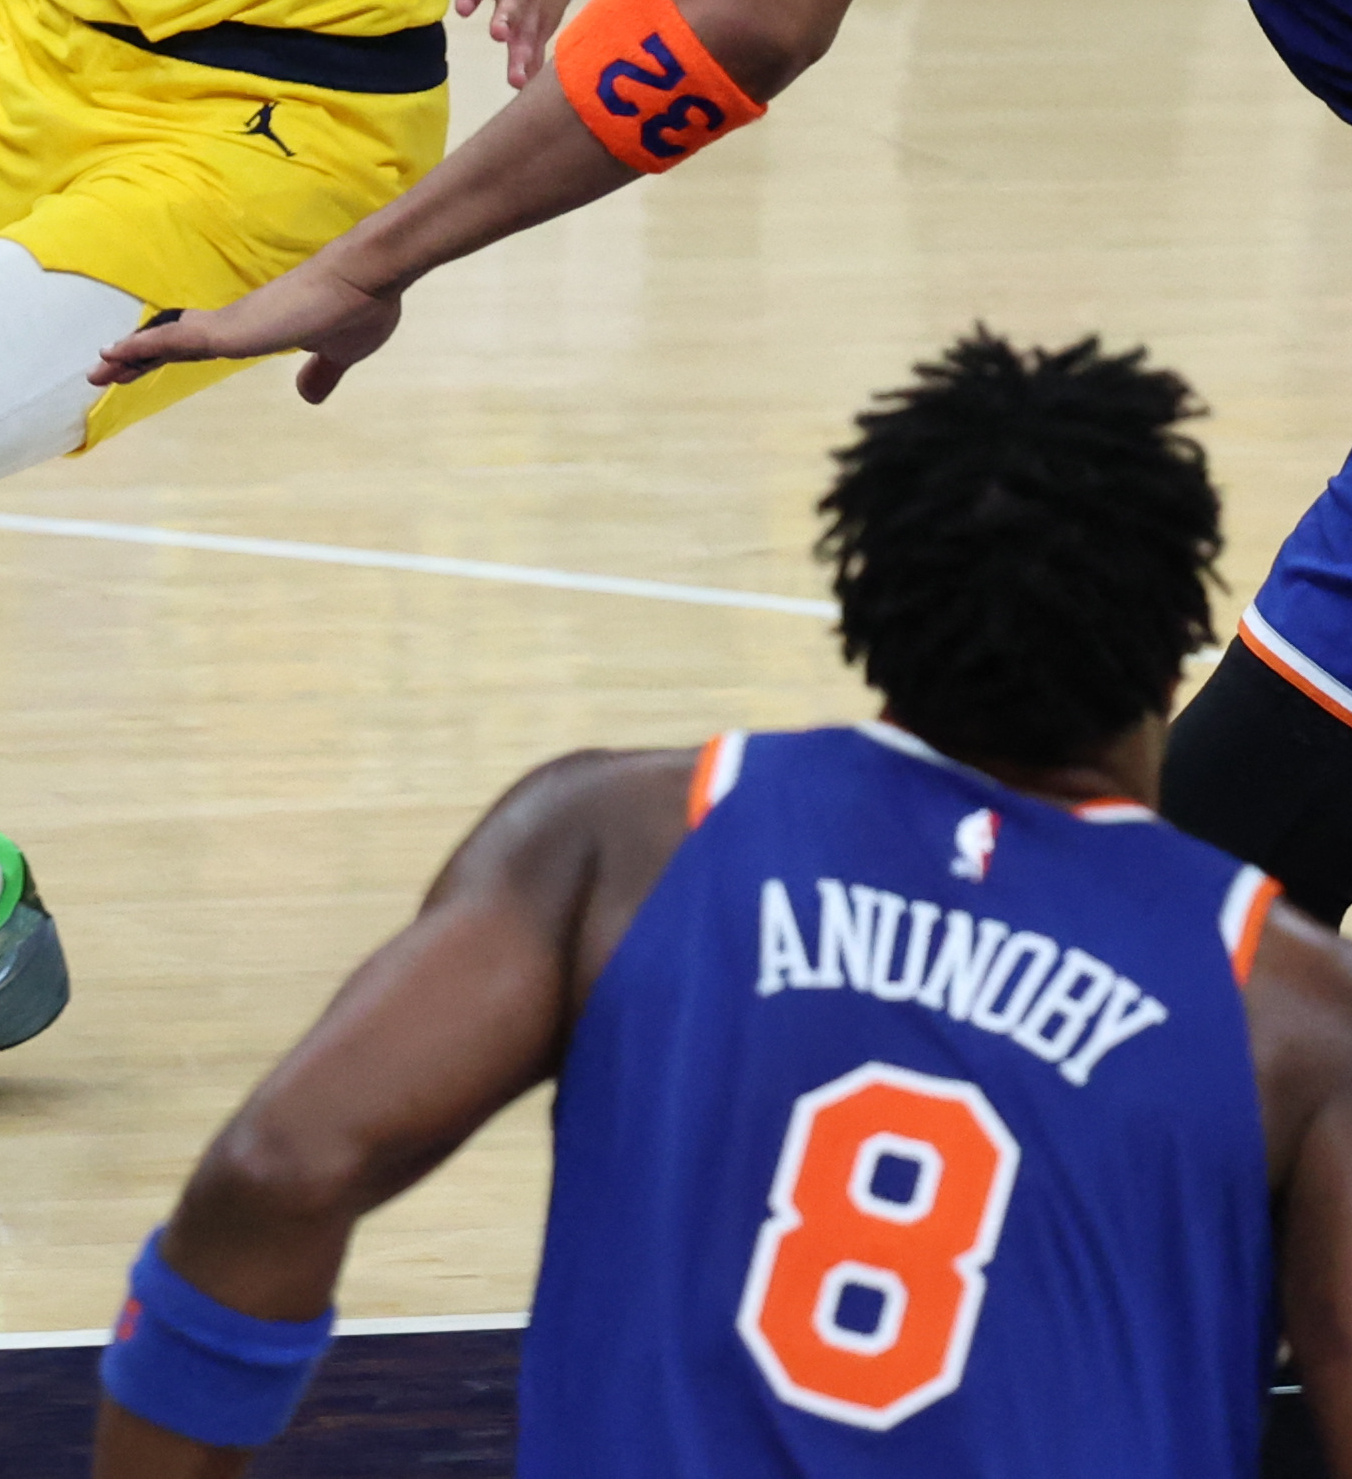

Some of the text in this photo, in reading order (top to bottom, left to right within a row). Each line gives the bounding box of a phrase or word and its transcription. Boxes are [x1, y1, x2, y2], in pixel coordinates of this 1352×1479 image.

[596, 31, 727, 159] 32
[758, 877, 1169, 1088] ANUNOBY
[736, 1059, 1022, 1432] 8
